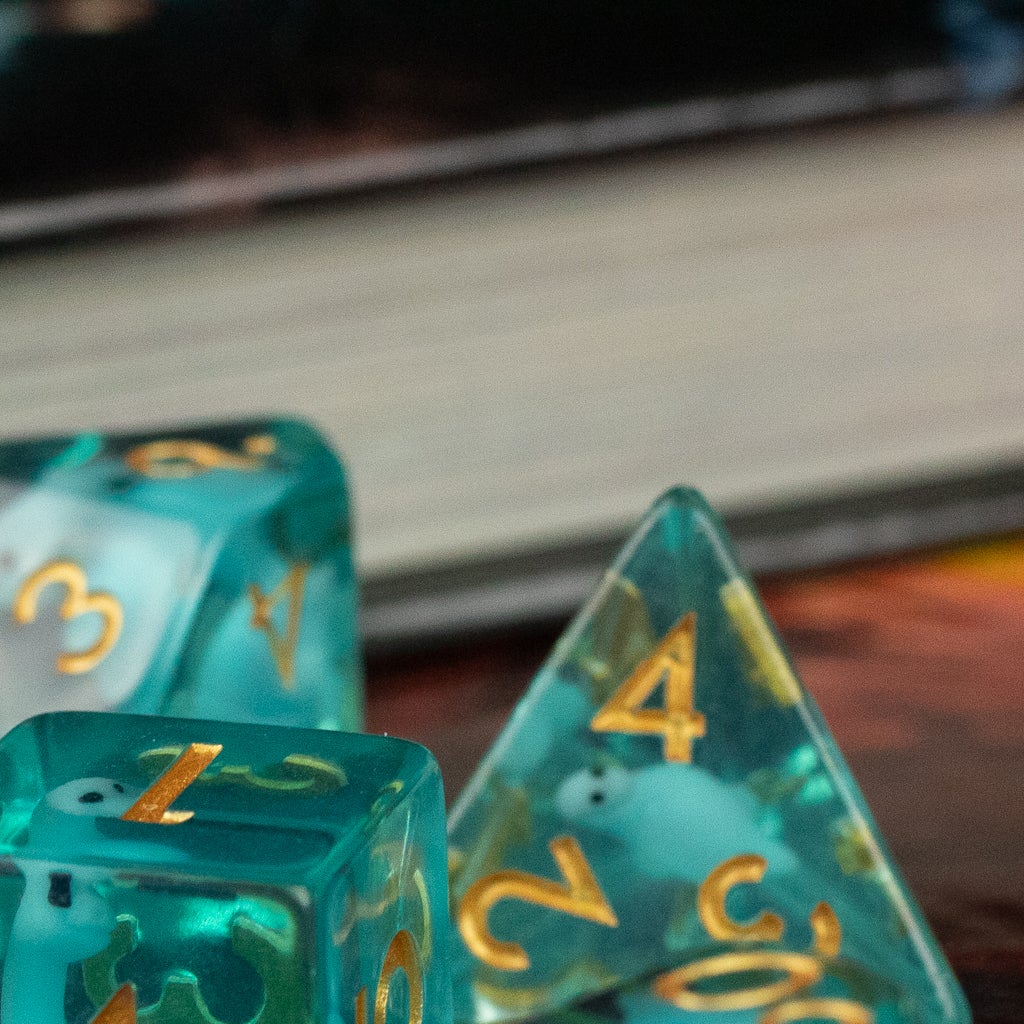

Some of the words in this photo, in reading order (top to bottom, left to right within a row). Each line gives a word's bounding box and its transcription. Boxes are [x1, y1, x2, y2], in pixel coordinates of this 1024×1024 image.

[13, 557, 125, 675] 3
[588, 610, 707, 765] 4
[121, 742, 223, 825] 1
[458, 835, 620, 972] 2
